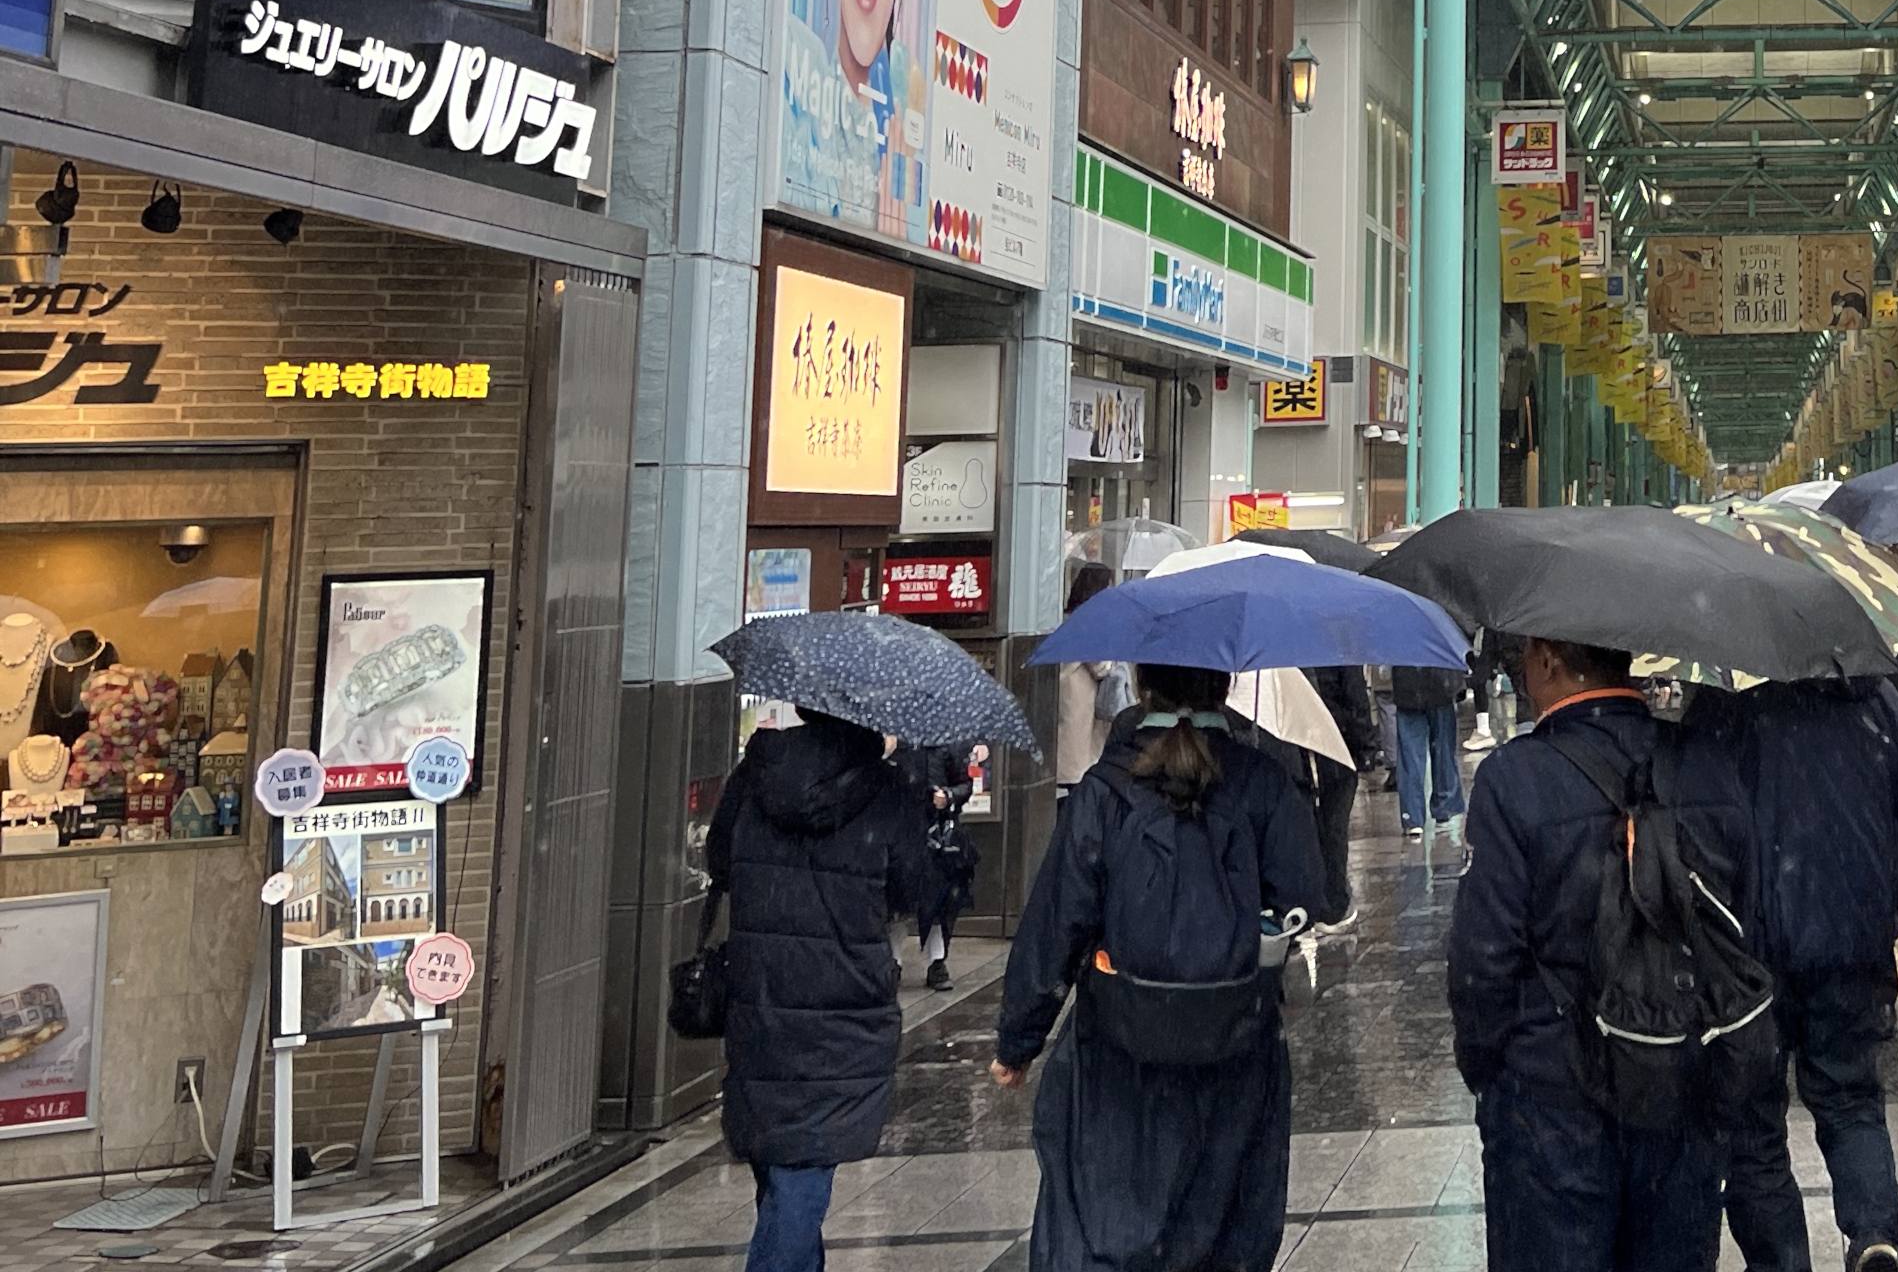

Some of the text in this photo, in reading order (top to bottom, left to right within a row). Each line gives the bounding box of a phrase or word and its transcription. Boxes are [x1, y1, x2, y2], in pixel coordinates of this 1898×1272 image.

[240, 0, 598, 181] ジュエリーサロン パルジュ
[944, 127, 974, 173] Miru
[263, 361, 490, 399] 吉祥寺街物語
[911, 462, 943, 477] Skin
[910, 478, 958, 492] Refine
[910, 493, 952, 507] Clinic
[948, 562, 982, 598] 龍
[268, 765, 313, 785] 入居者
[324, 768, 410, 788] SALE SAL
[291, 807, 407, 833] 吉祥寺街物語
[428, 952, 456, 969] 内見
[417, 967, 462, 984] できます
[24, 1099, 71, 1119] SALE
